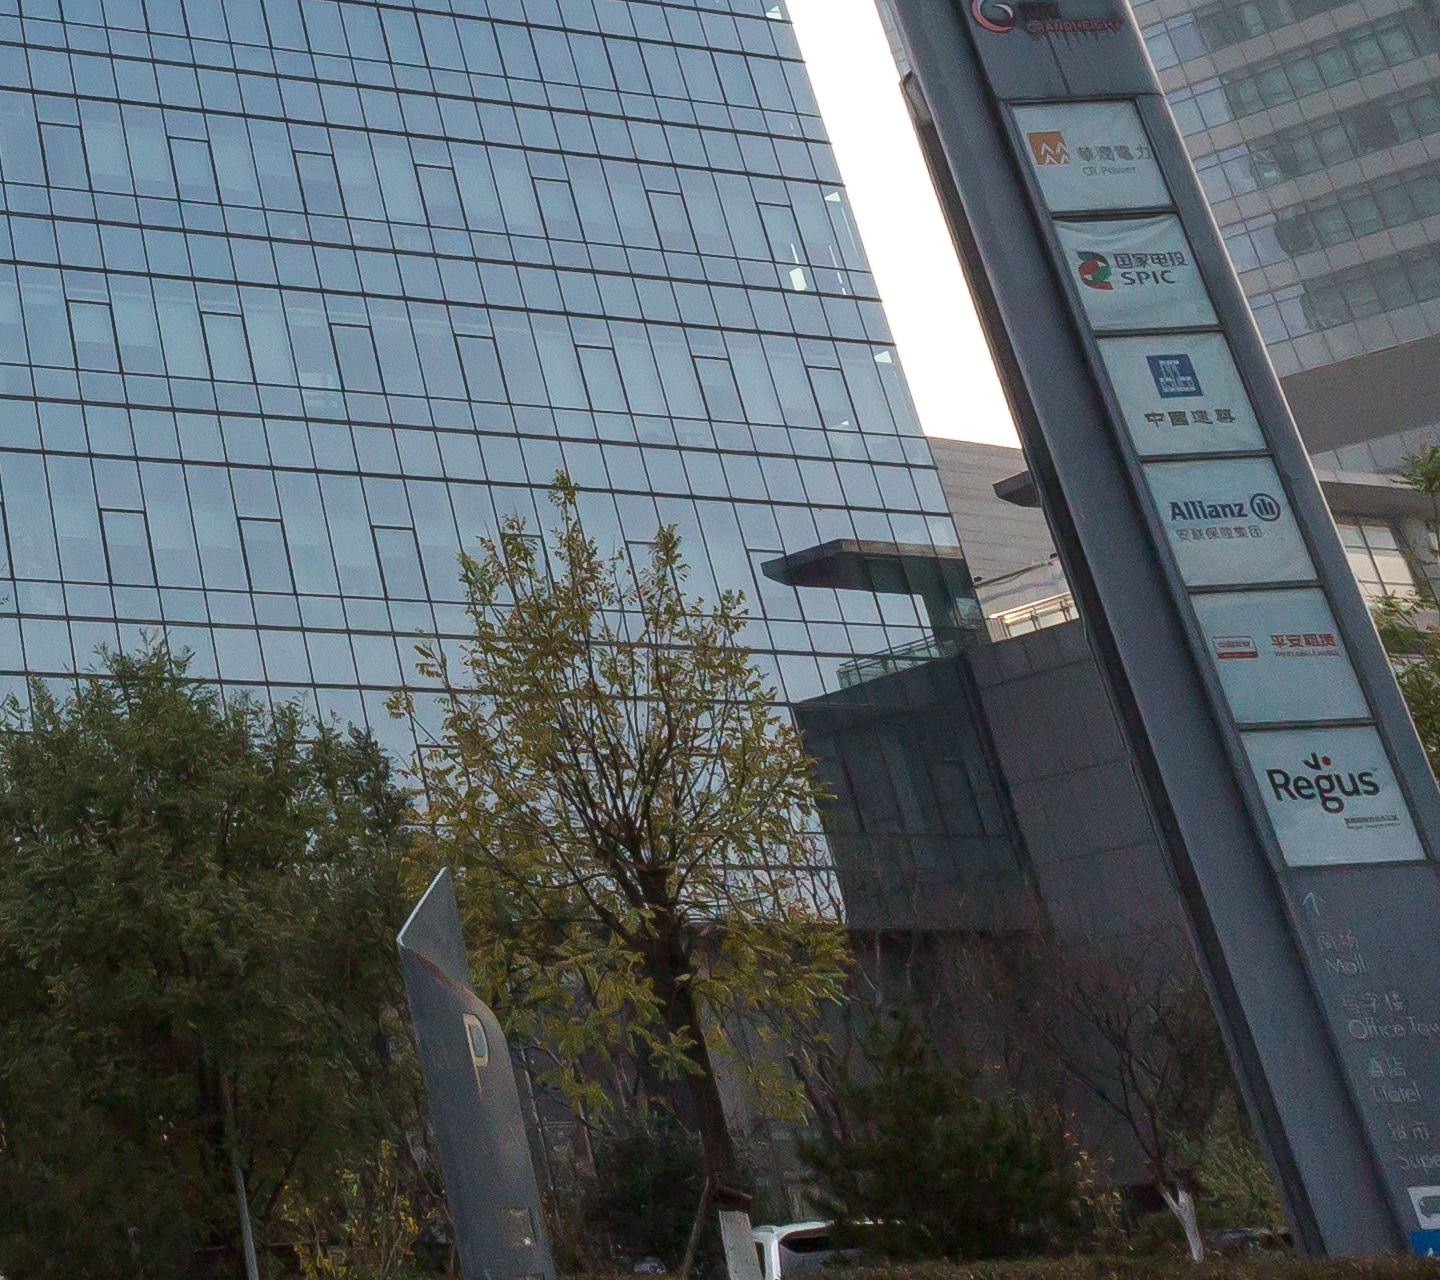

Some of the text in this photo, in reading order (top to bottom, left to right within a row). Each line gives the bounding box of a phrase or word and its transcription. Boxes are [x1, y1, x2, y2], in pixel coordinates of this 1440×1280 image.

[1121, 270, 1176, 286] SPIC
[1170, 500, 1248, 521] Allianz
[1266, 768, 1380, 814] Regus
[1348, 1016, 1405, 1039] Office
